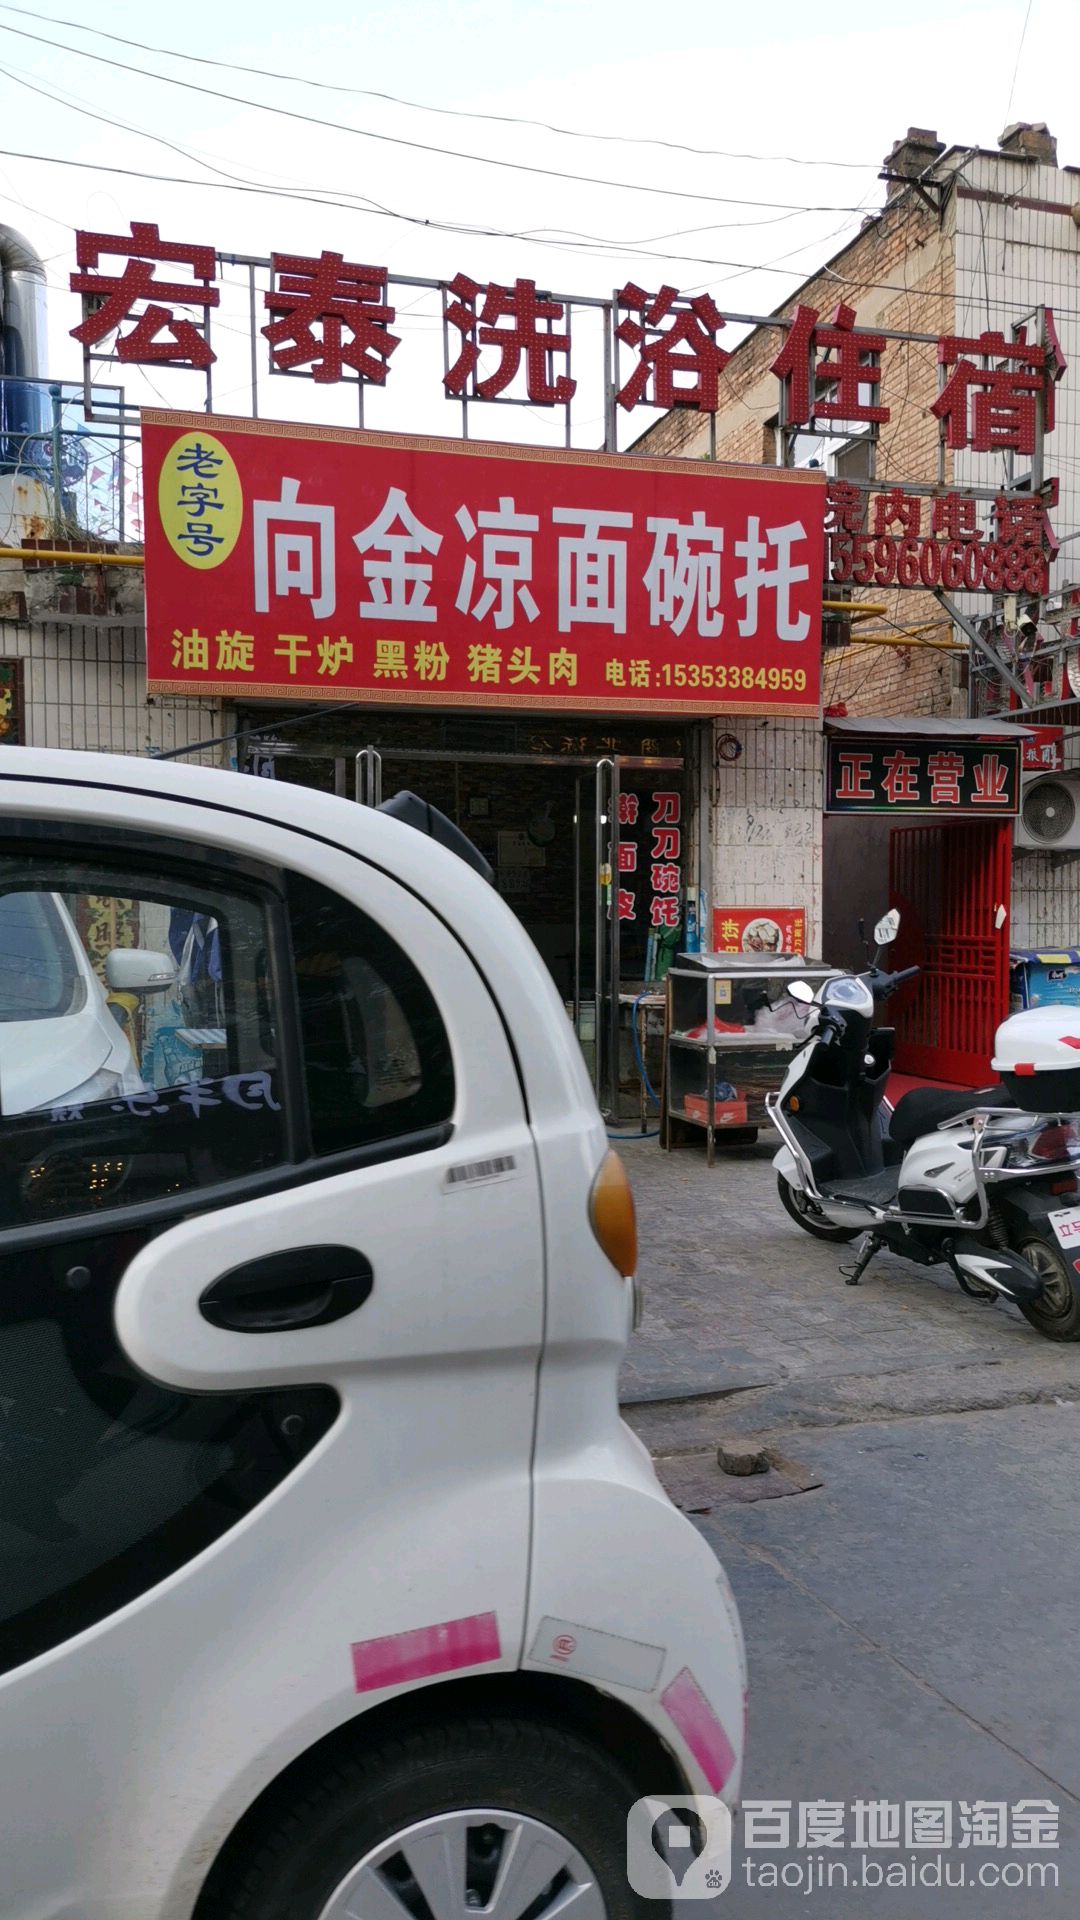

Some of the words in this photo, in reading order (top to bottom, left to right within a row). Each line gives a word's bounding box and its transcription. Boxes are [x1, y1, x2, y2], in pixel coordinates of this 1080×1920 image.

[70, 221, 1045, 456] 宏泰洗浴住宿
[176, 442, 225, 557] 老字号
[252, 476, 811, 642] 向金凉面碗托
[170, 628, 256, 673] 油旋
[273, 633, 355, 677] 干炉
[373, 640, 451, 682] 黑粉
[466, 643, 579, 686] 猪头肉
[605, 658, 807, 692] 电话:15353384959
[835, 751, 1010, 805] 正在营业
